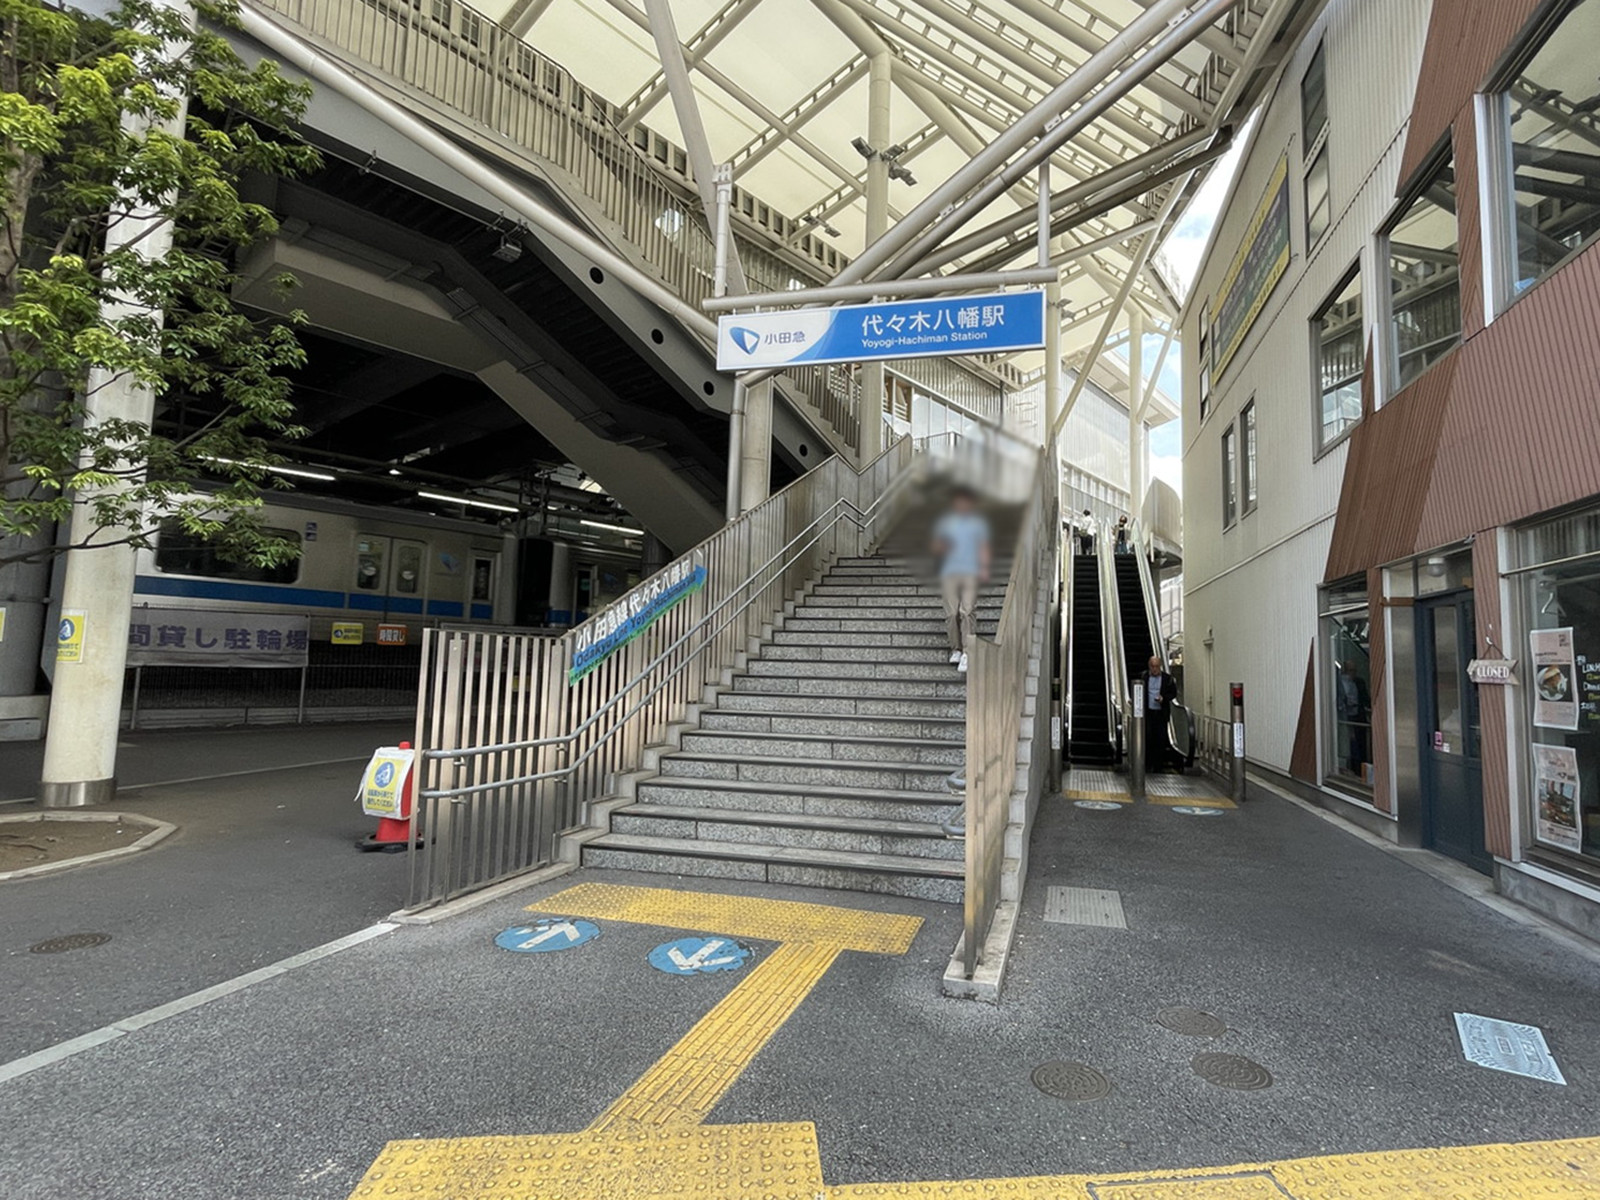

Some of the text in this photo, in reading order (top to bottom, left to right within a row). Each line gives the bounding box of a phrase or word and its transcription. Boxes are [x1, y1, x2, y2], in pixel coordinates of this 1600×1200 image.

[861, 304, 1005, 337] 代々木八幡駅
[764, 331, 806, 345] 小田急
[861, 330, 988, 349] Yoyogi-Hachiman Station
[1477, 666, 1509, 679] CLOSED
